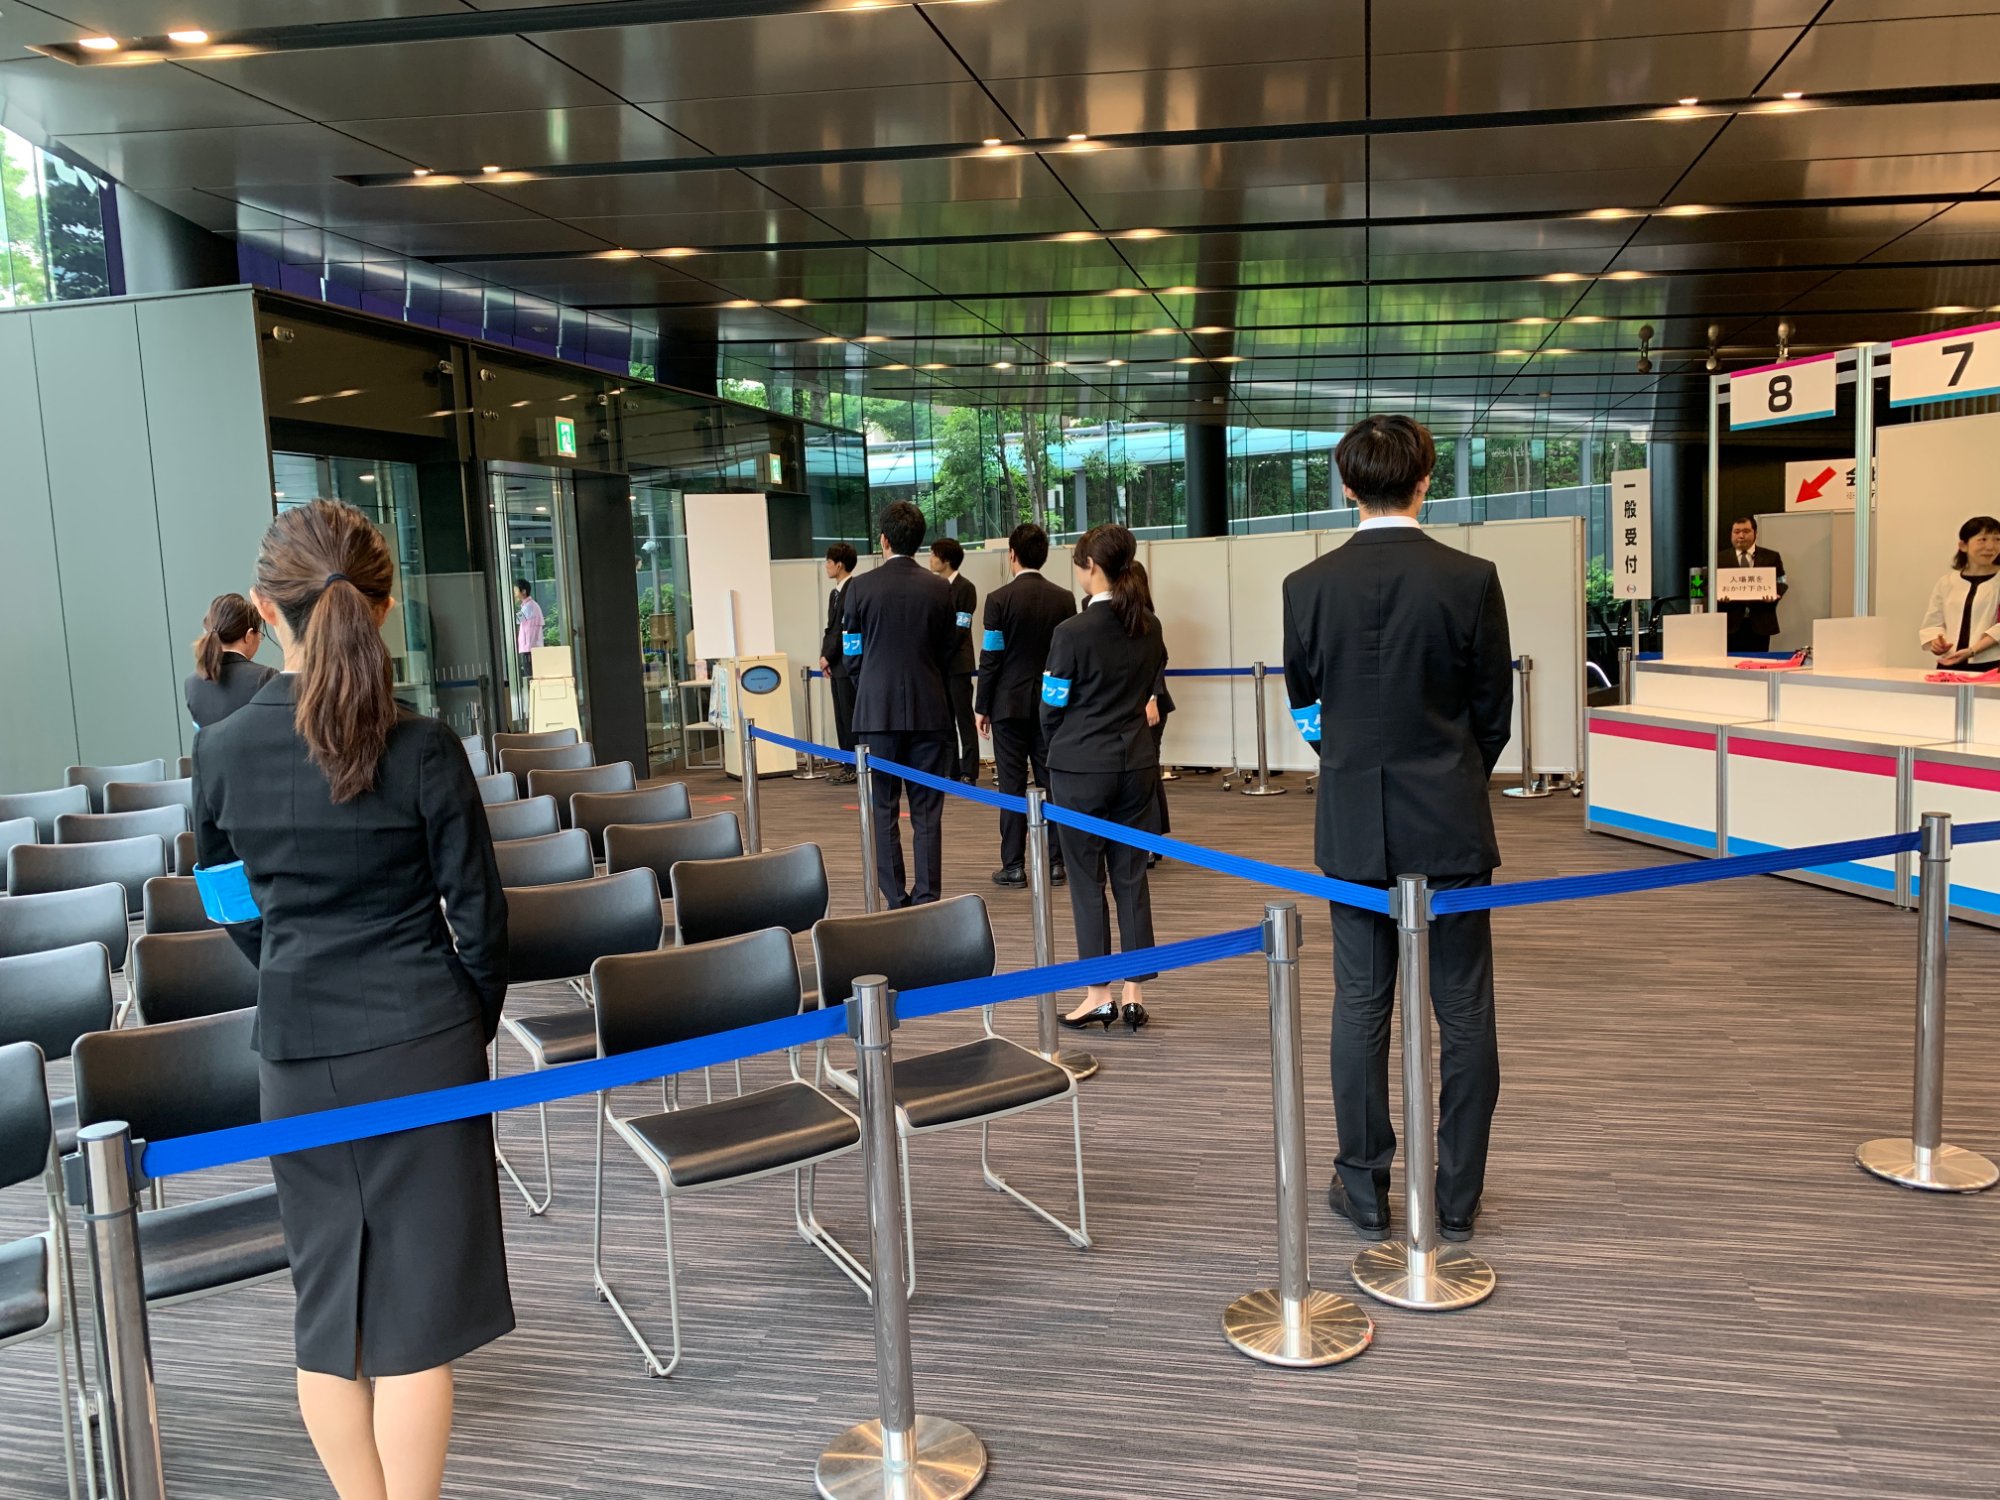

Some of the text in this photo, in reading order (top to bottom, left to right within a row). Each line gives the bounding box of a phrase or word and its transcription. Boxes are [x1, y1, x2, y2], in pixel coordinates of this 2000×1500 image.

[1942, 341, 1974, 387] 7
[1768, 374, 1793, 413] 8
[1623, 483, 1638, 574] 一般受付
